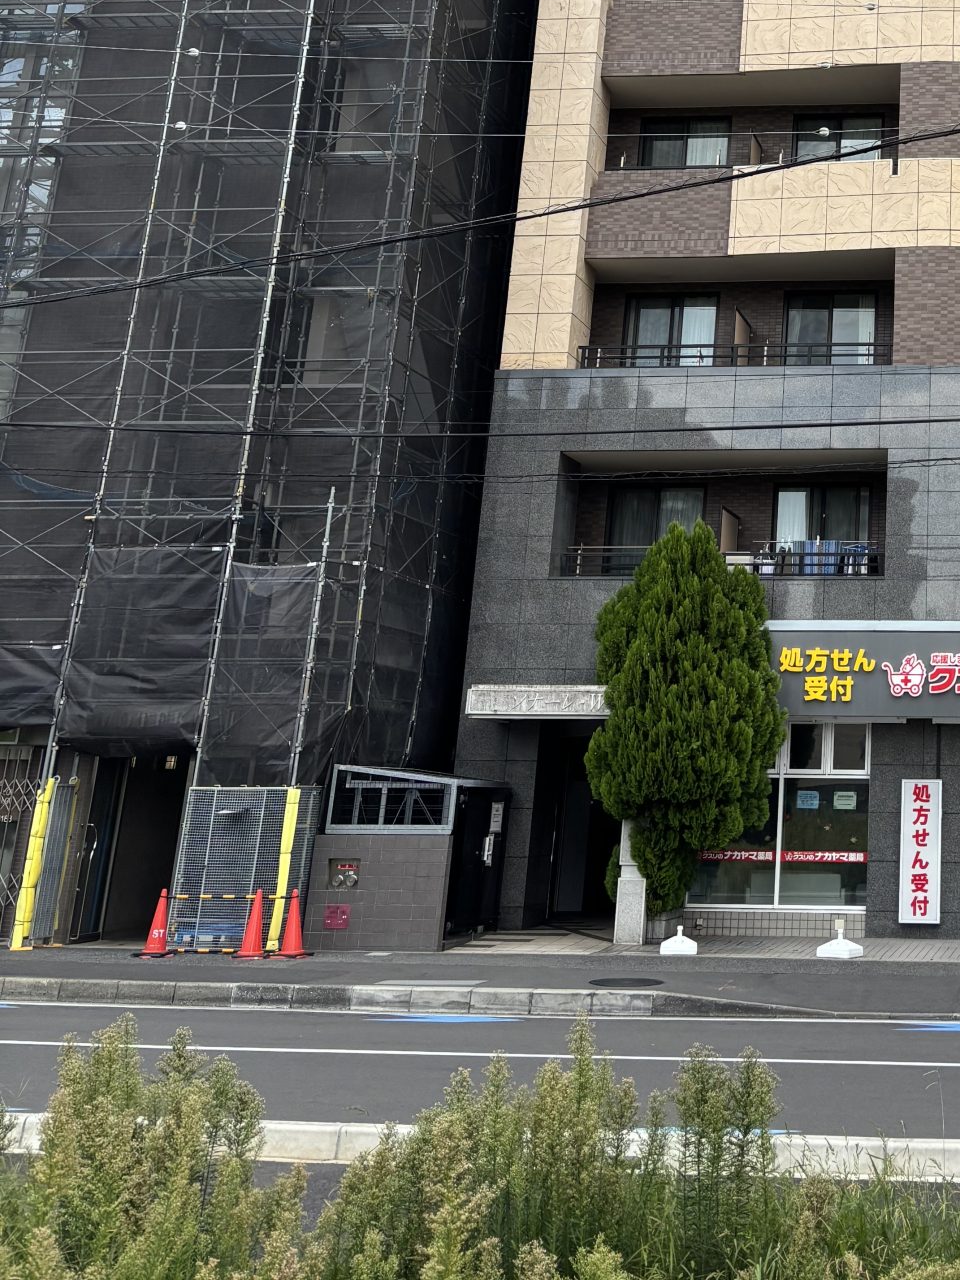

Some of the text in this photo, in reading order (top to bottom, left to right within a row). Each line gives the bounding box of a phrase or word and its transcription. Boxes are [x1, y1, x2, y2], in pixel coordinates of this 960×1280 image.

[779, 646, 876, 674] 処方せん
[804, 675, 854, 703] 受付
[910, 783, 931, 917] 処方せん受付
[152, 929, 166, 939] ST
